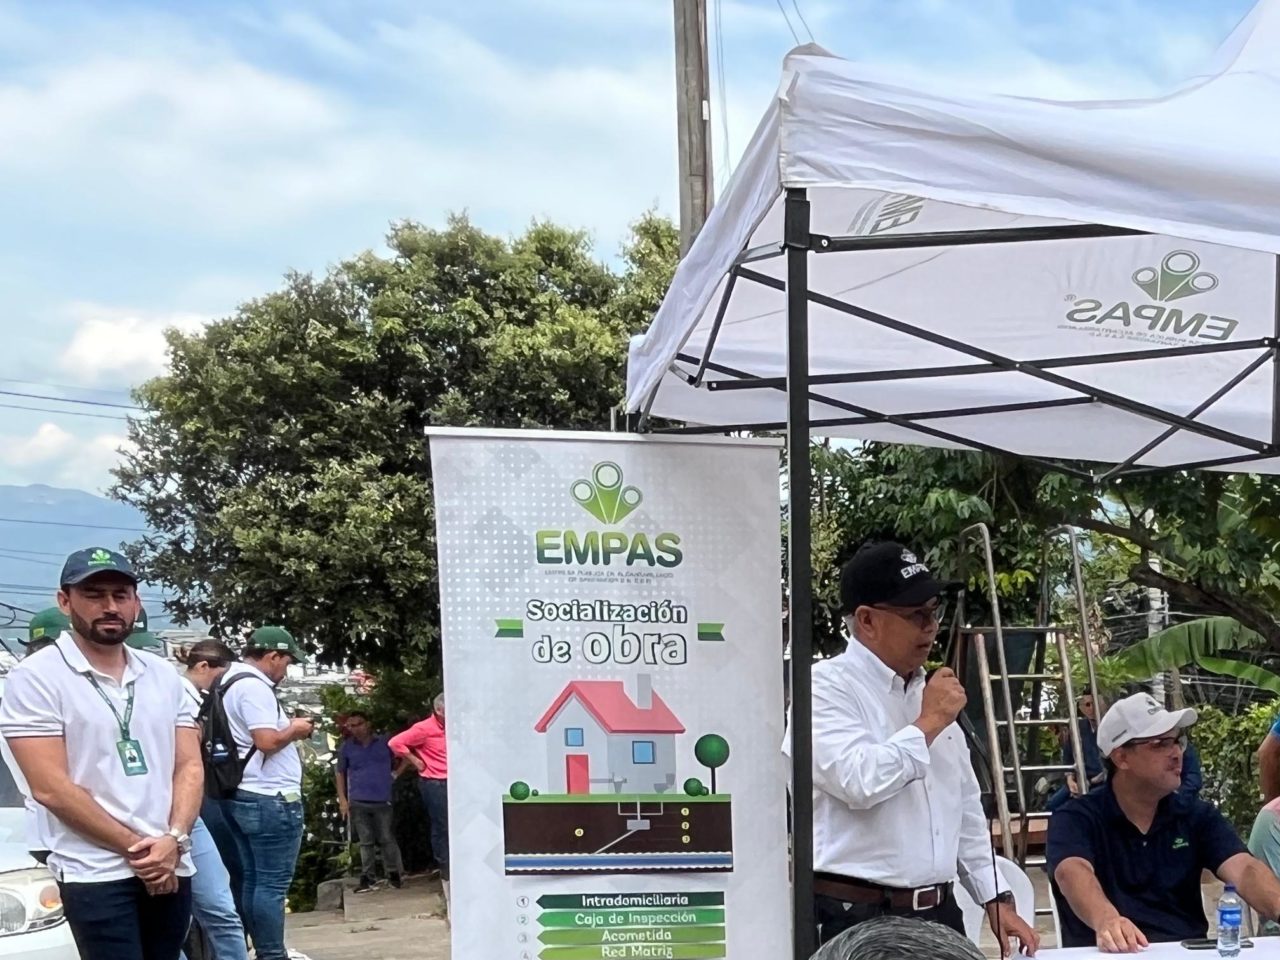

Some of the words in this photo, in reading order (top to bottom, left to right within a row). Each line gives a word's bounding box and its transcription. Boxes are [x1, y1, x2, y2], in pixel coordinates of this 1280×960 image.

[535, 529, 684, 568] EMPAS
[526, 599, 688, 624] Socialización
[532, 634, 572, 664] de
[582, 624, 688, 665] obra
[582, 894, 689, 907] Intradomiciliaria
[574, 913, 604, 928] Caja
[608, 913, 625, 925] de
[629, 911, 697, 927] Inspección
[602, 928, 673, 942] Acometida
[601, 945, 626, 958] Red
[631, 944, 674, 959] Matriz
